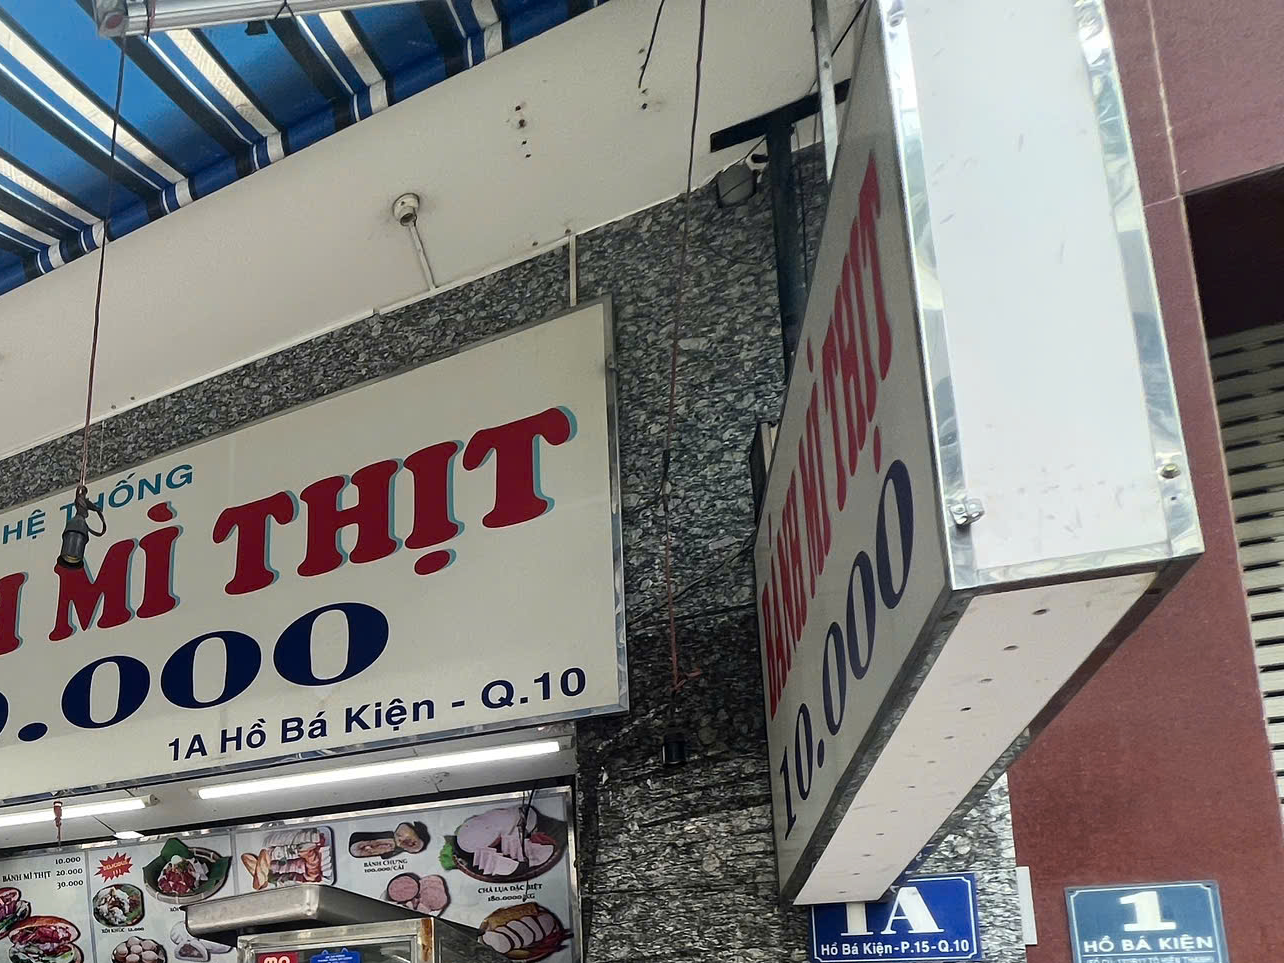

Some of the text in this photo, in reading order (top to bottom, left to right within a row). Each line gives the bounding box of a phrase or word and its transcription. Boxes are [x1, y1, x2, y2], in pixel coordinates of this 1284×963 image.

[762, 470, 808, 722] BÁNH
[822, 150, 892, 512] THỊT
[2, 509, 45, 545] HỆ
[49, 501, 183, 641] MÌ
[212, 405, 577, 595] THỊT
[780, 459, 914, 841] 10.000
[168, 734, 207, 761] 1A
[220, 717, 266, 754] Hồ
[280, 711, 328, 745] Bá
[345, 698, 435, 733] Kiện
[480, 667, 587, 709] Q.10
[56, 868, 83, 876] 20.000
[57, 880, 84, 890] 30.000
[841, 887, 944, 936] 1A
[1120, 891, 1177, 932] 1
[842, 943, 859, 956] Bá
[1121, 936, 1151, 951] BÁ
[1159, 934, 1214, 952] KIỆN
